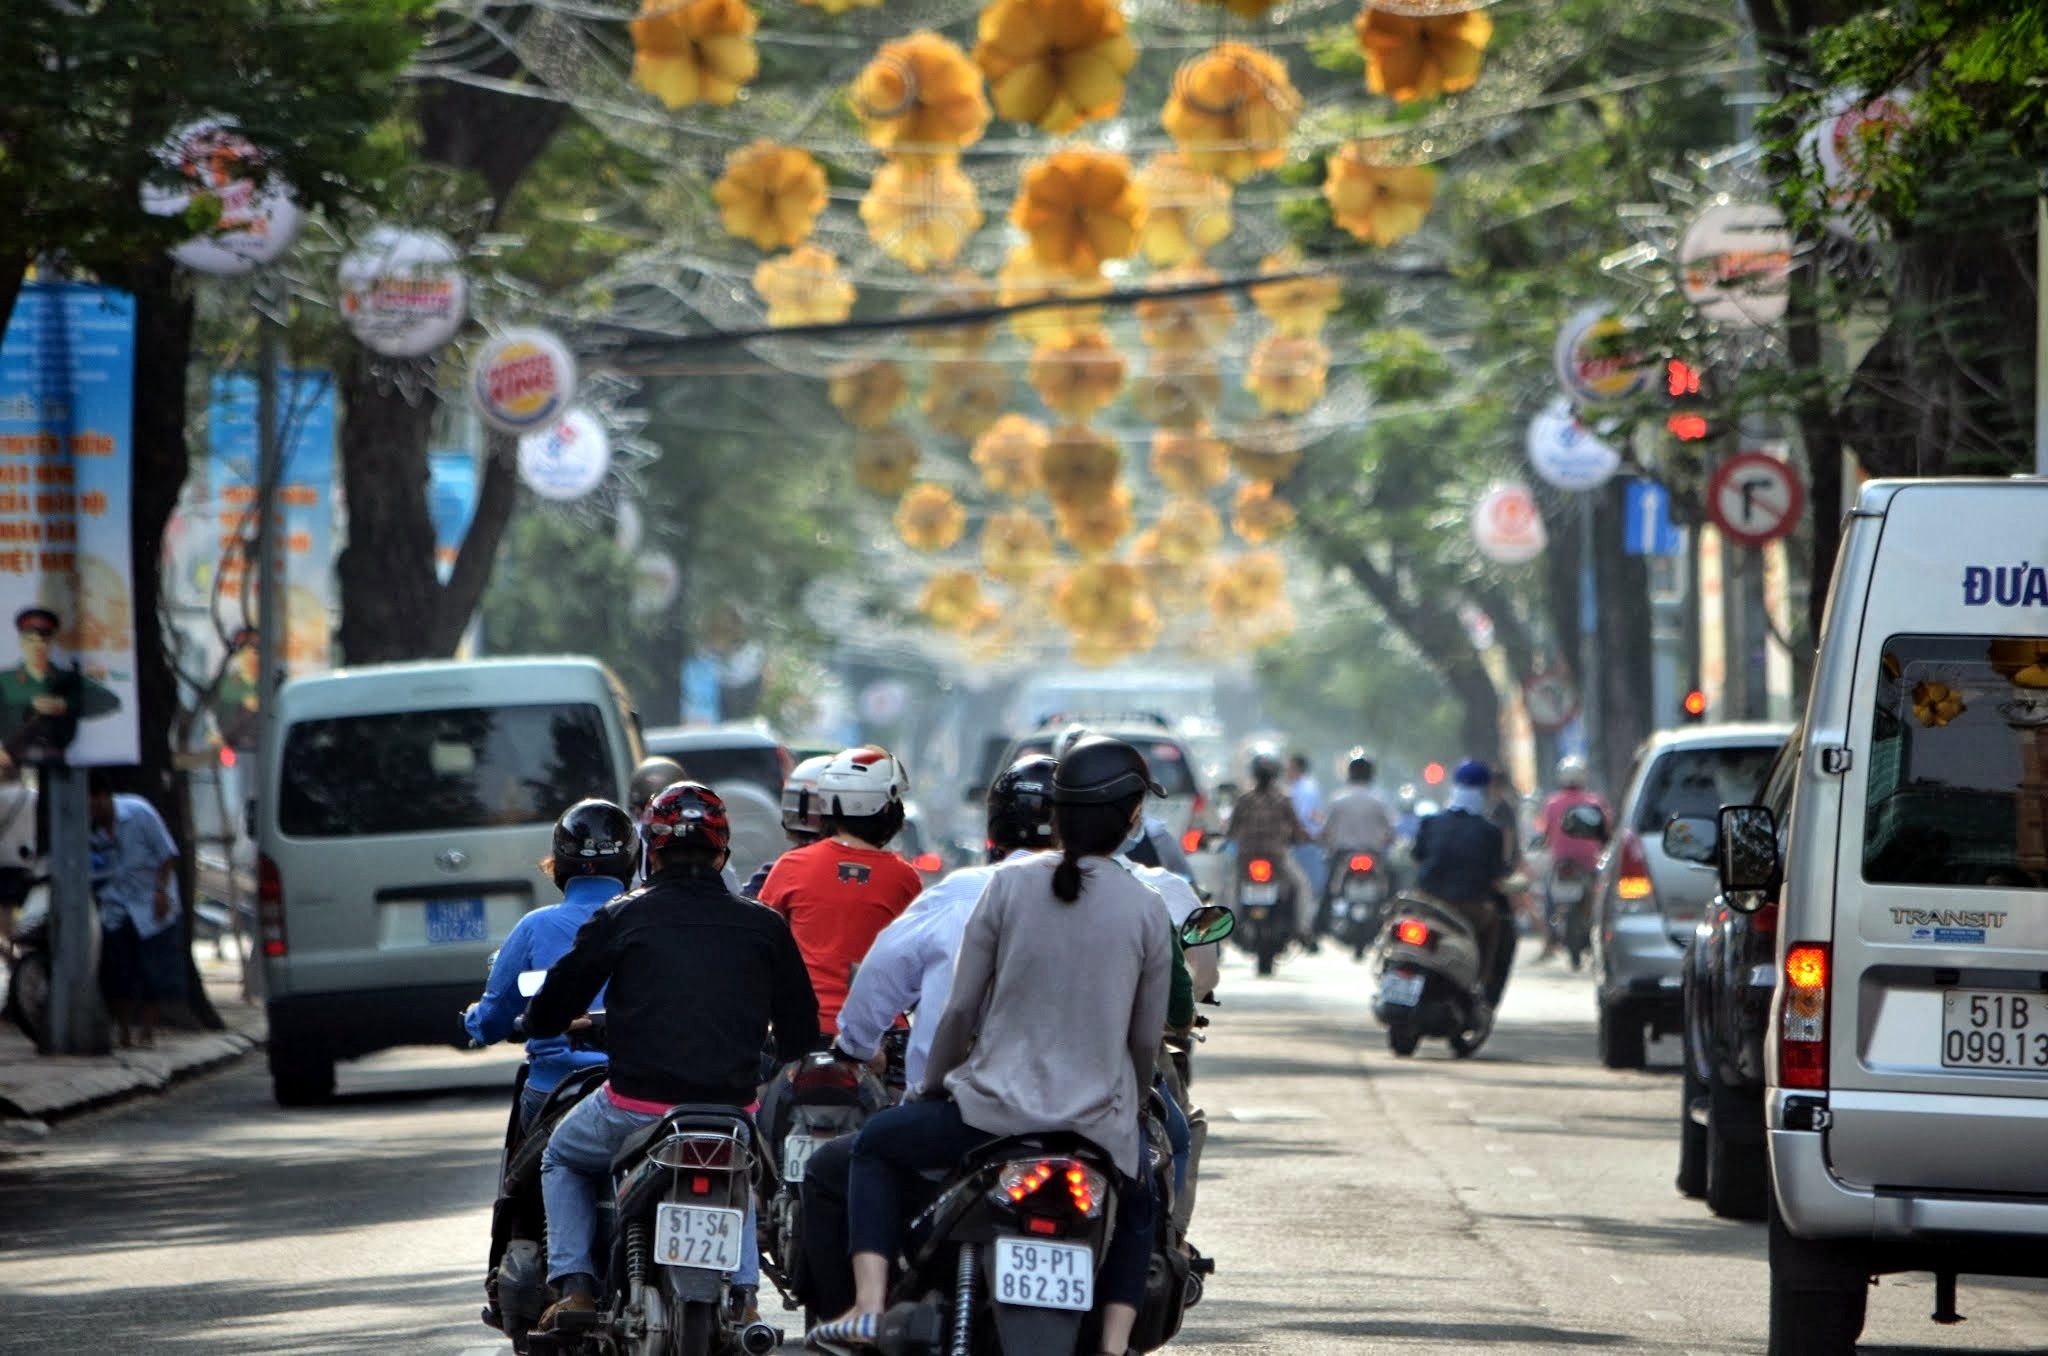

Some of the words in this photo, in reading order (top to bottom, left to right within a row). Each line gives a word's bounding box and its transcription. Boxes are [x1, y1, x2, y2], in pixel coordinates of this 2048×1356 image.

[1962, 560, 2048, 607] ĐƯA
[1888, 907, 2008, 928] TRANSIT
[1970, 994, 2029, 1029] 51B
[1946, 1029, 2048, 1066] 099.13
[668, 1236, 727, 1265] 8724
[1011, 1245, 1073, 1276] 59-P1
[1003, 1272, 1085, 1305] 862.35
